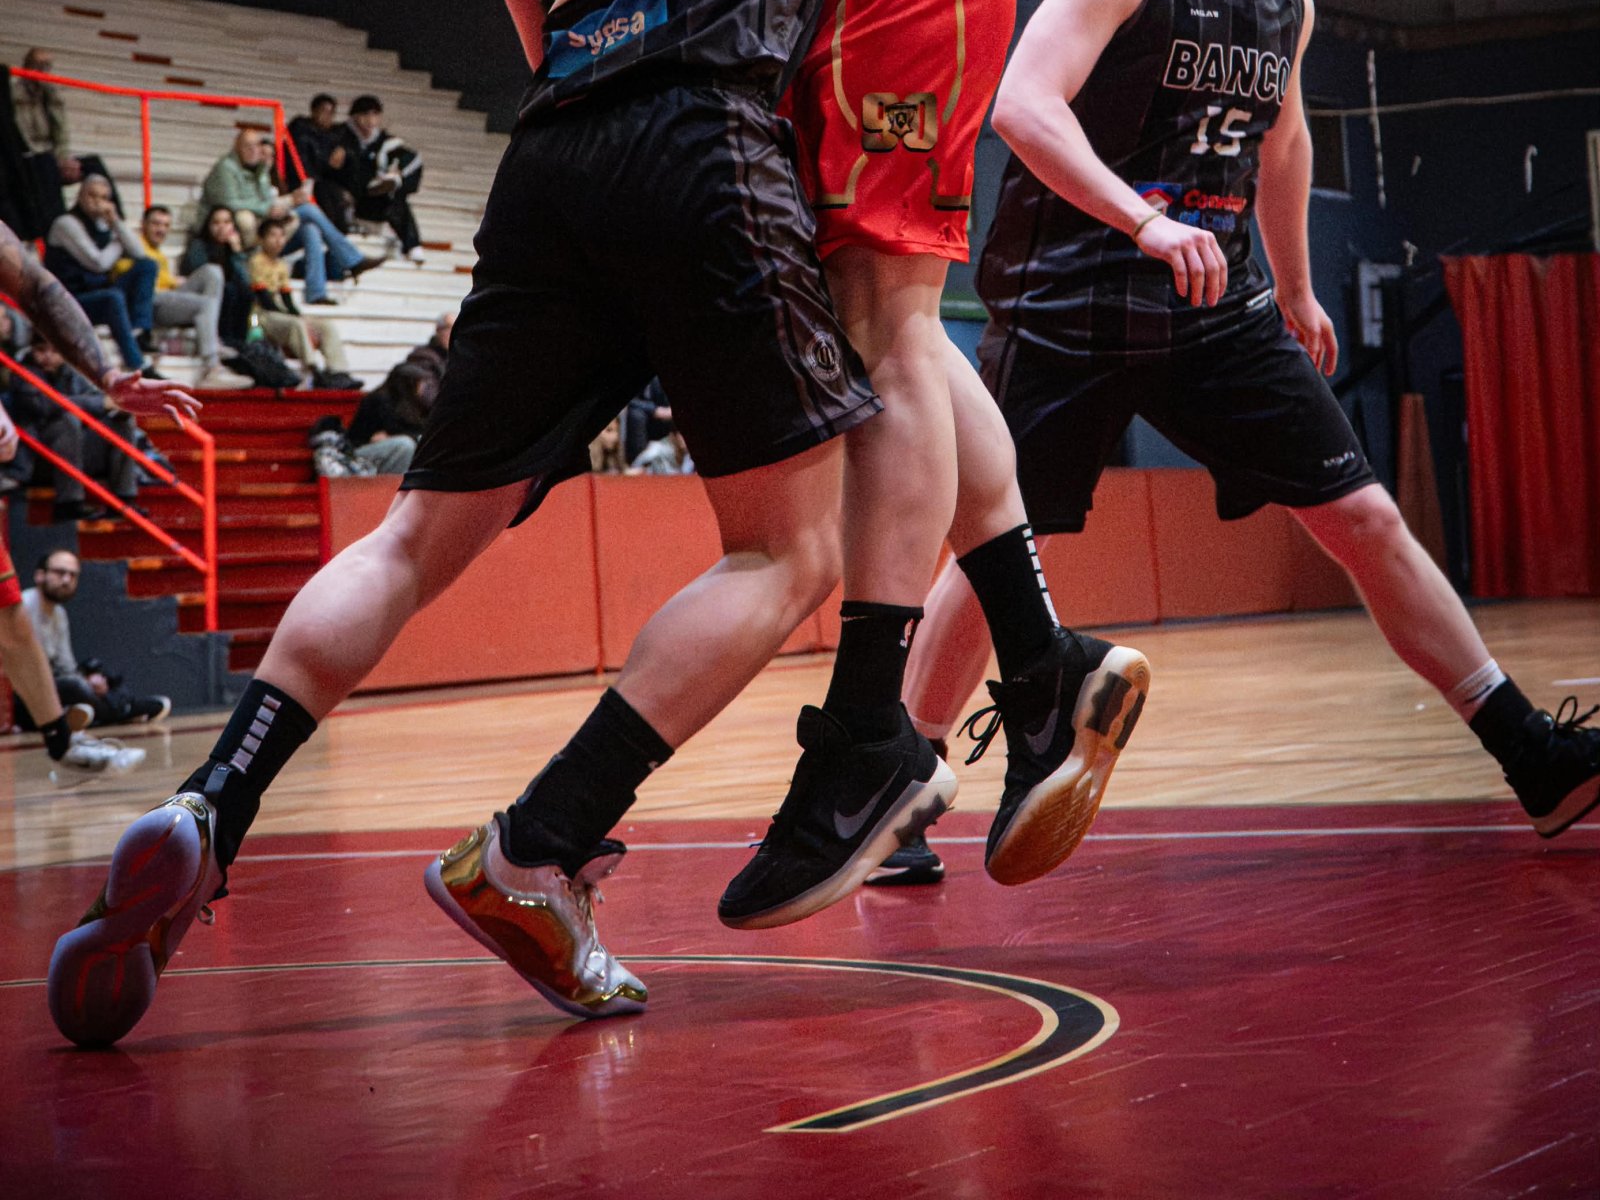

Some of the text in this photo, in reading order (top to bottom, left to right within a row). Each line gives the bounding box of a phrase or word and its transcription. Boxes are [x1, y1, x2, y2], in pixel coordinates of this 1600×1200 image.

[1162, 39, 1290, 106] BANCO
[861, 91, 938, 153] 90
[1189, 105, 1254, 157] 15
